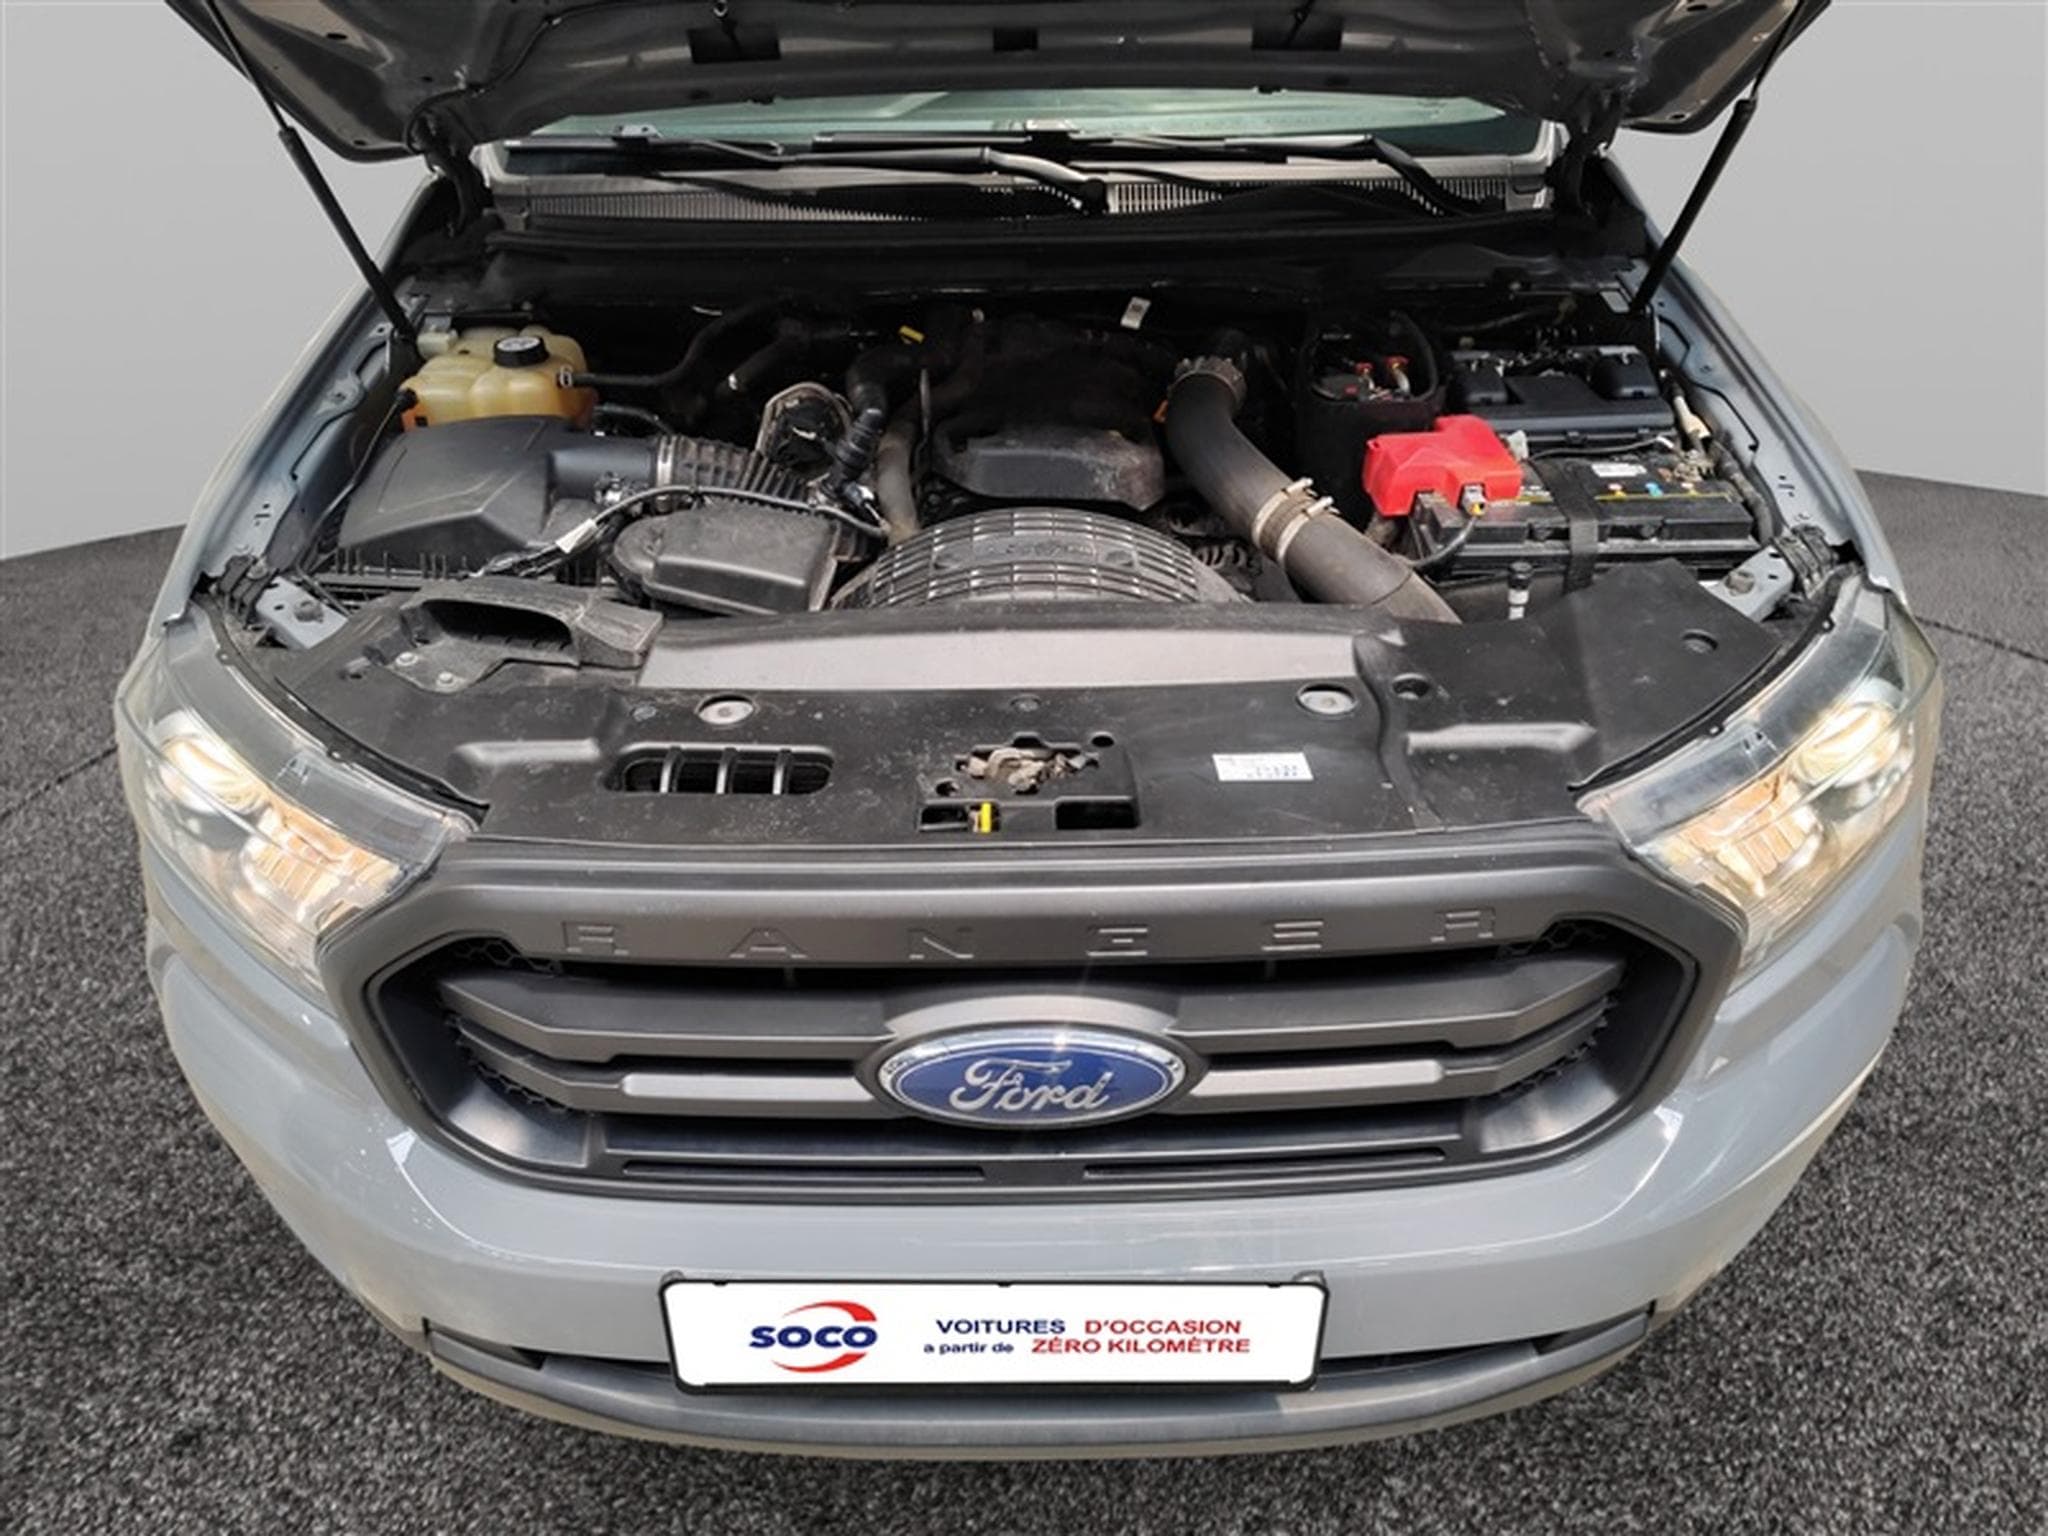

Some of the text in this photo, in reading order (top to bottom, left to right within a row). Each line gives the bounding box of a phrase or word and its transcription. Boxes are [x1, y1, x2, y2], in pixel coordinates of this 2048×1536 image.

[561, 907, 1497, 957] RANGER
[948, 1056, 1114, 1112] Ford
[749, 1325, 878, 1348] SOCO
[936, 1319, 1241, 1334] VOITURES D'OCCASION
[939, 1341, 987, 1355] partir
[991, 1341, 1014, 1354] de
[1032, 1336, 1102, 1354] ZÉRO
